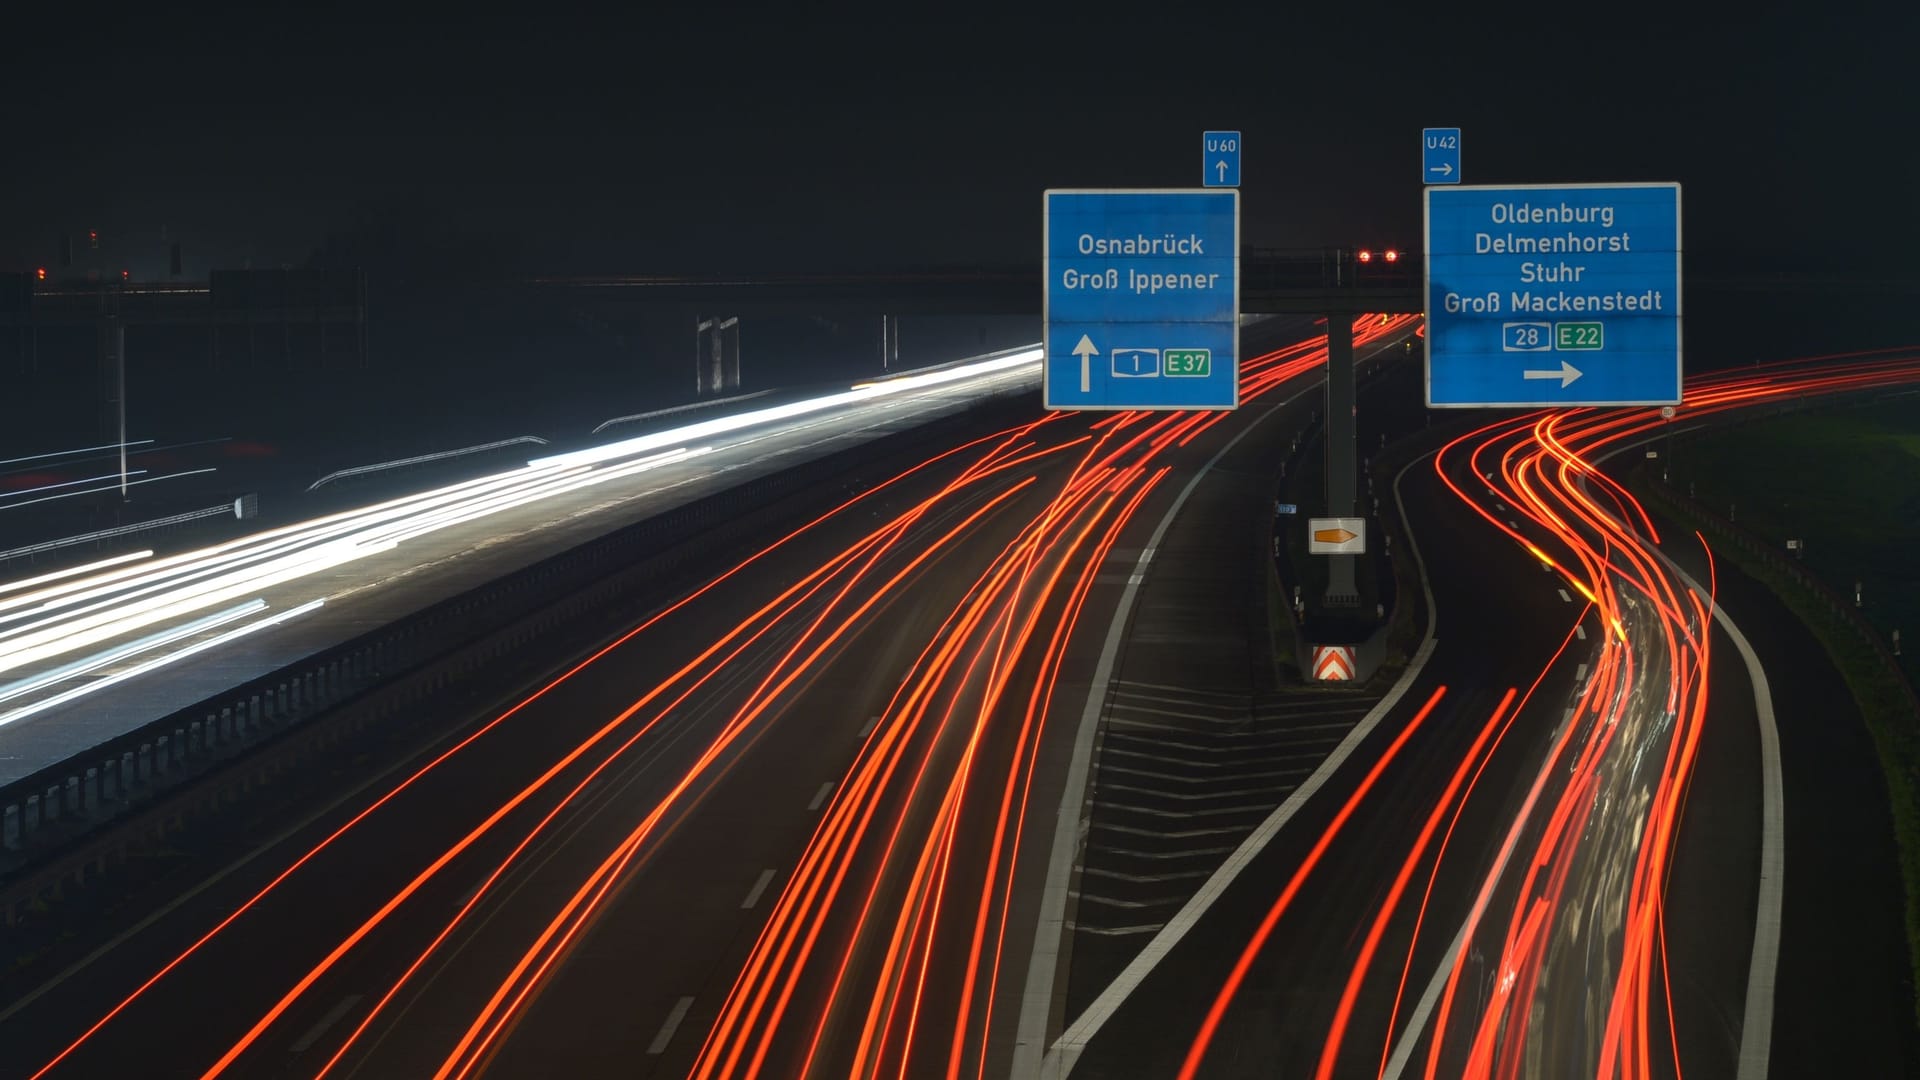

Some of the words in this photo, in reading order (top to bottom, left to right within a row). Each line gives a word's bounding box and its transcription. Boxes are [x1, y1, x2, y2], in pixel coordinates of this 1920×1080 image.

[1207, 139, 1218, 152] U
[1219, 139, 1236, 152] 60
[1427, 136, 1437, 149] U
[1439, 136, 1456, 149] 42
[1491, 202, 1614, 227] Oldenburg
[1078, 233, 1204, 255] Osnabrück
[1475, 231, 1630, 254] Delmenhorst
[1063, 268, 1118, 290] Groß
[1129, 268, 1219, 294] Ippener
[1520, 261, 1585, 283] Stuhr
[1444, 291, 1500, 313] Groß
[1511, 290, 1662, 312] Mackenstedt
[1515, 328, 1538, 346] 28
[1560, 327, 1572, 345] E
[1576, 327, 1599, 345] 22
[1131, 354, 1139, 372] 1
[1168, 354, 1180, 372] E
[1183, 353, 1206, 372] 37
